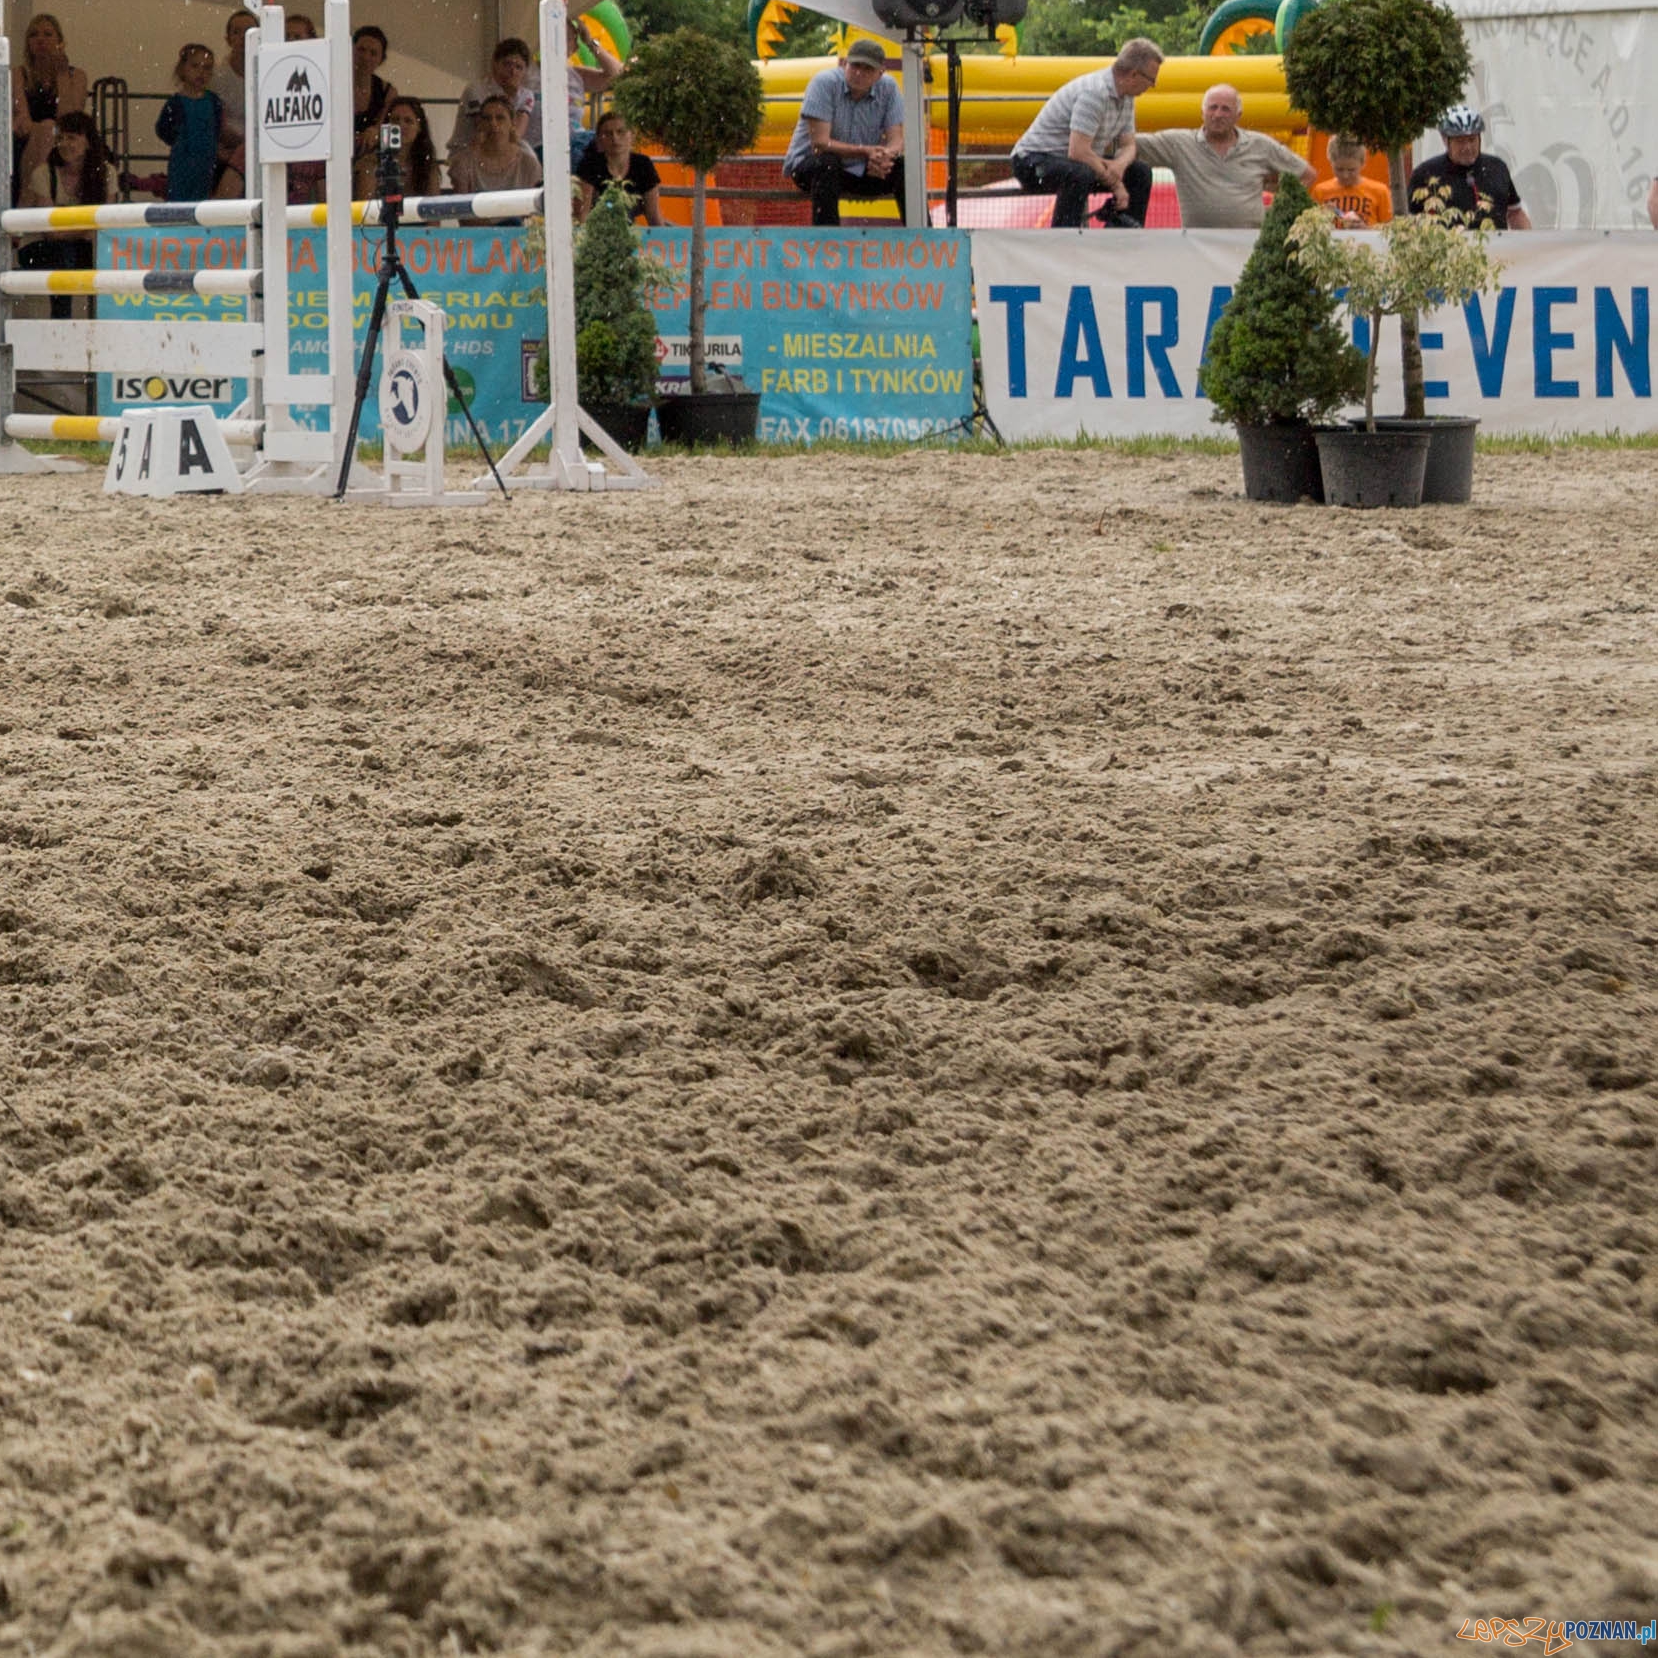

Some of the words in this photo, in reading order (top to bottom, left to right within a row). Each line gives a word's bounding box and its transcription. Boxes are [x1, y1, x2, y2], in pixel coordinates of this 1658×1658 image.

[265, 94, 323, 123] ALFAKO
[782, 234, 960, 270] SYSTEMÓW
[762, 274, 945, 311] BUDYNKÓW
[453, 340, 494, 355] HDS
[670, 343, 741, 356] TIKURILA
[784, 333, 937, 359] MIESZALNIA
[989, 286, 1371, 398] TAR
[761, 369, 829, 394] FARB
[850, 364, 964, 394] TYNKÓW
[760, 417, 812, 440] FAX
[116, 427, 130, 481] 5
[138, 423, 153, 481] A
[178, 419, 214, 475] A
